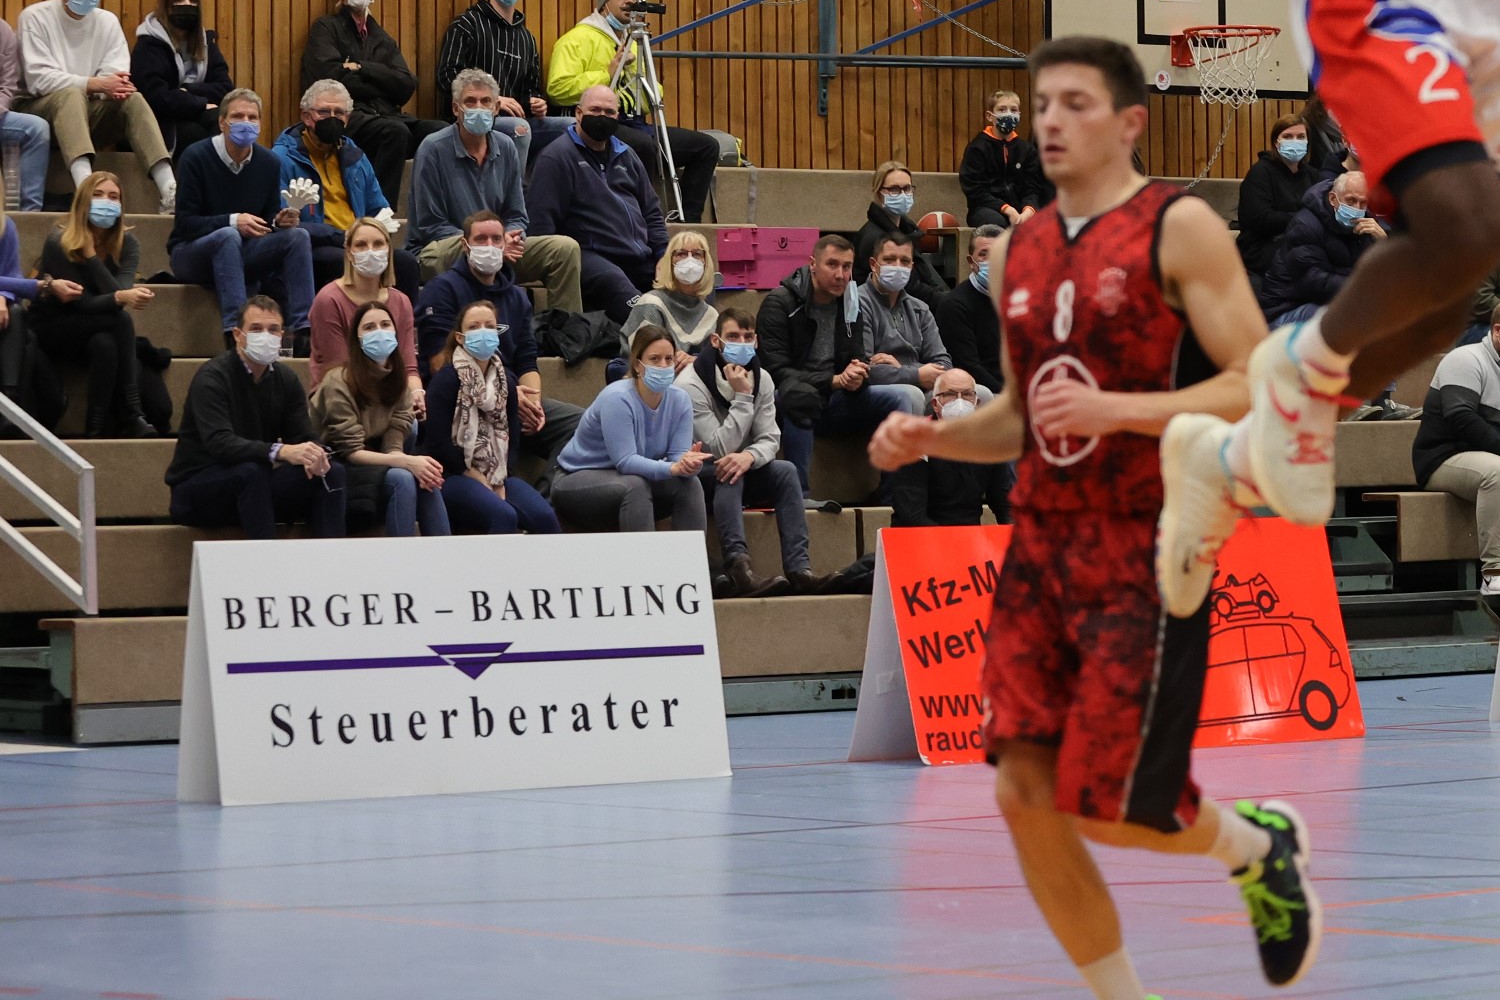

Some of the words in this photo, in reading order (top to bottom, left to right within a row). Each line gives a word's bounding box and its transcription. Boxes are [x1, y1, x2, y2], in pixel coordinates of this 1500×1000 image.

[1404, 43, 1460, 104] 2
[1053, 279, 1075, 342] 8
[223, 592, 419, 631] BERGER
[471, 582, 703, 622] BARTLING
[271, 690, 682, 748] Steuerberater
